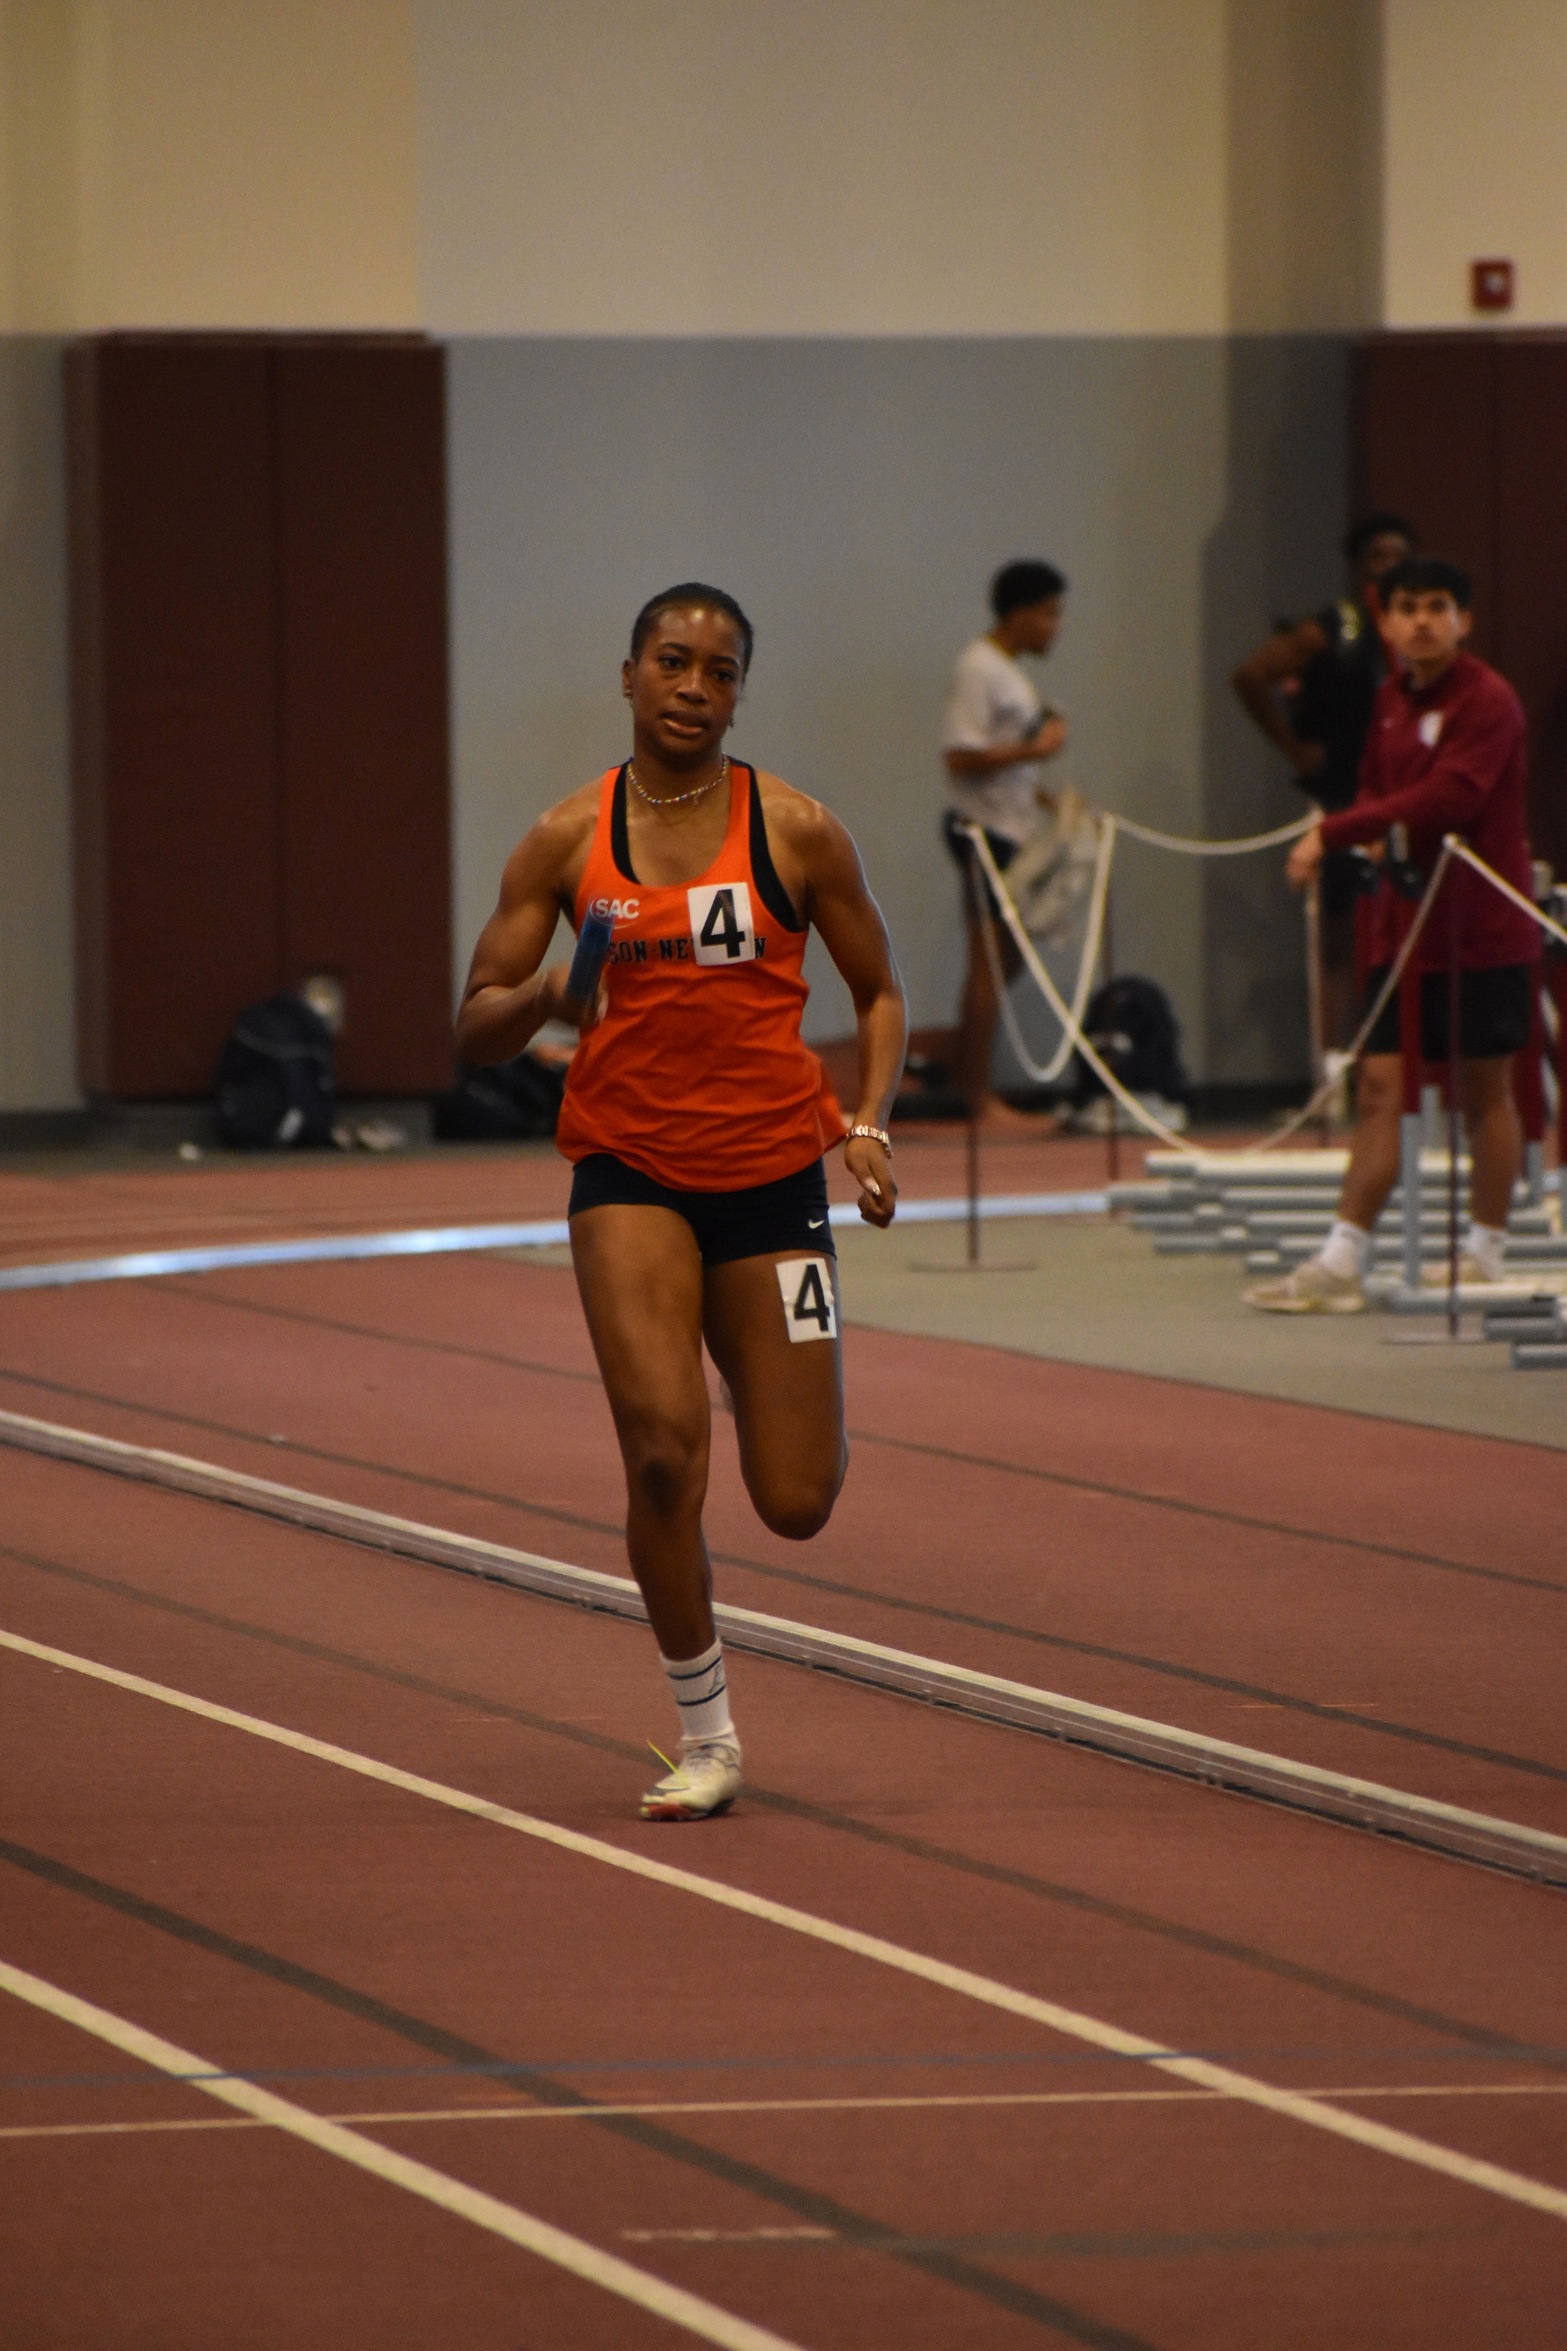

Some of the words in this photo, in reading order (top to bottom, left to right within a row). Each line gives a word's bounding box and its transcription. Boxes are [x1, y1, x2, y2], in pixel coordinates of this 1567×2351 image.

[595, 898, 640, 919] SAC
[701, 888, 746, 959] 4
[794, 1264, 831, 1332] 4
